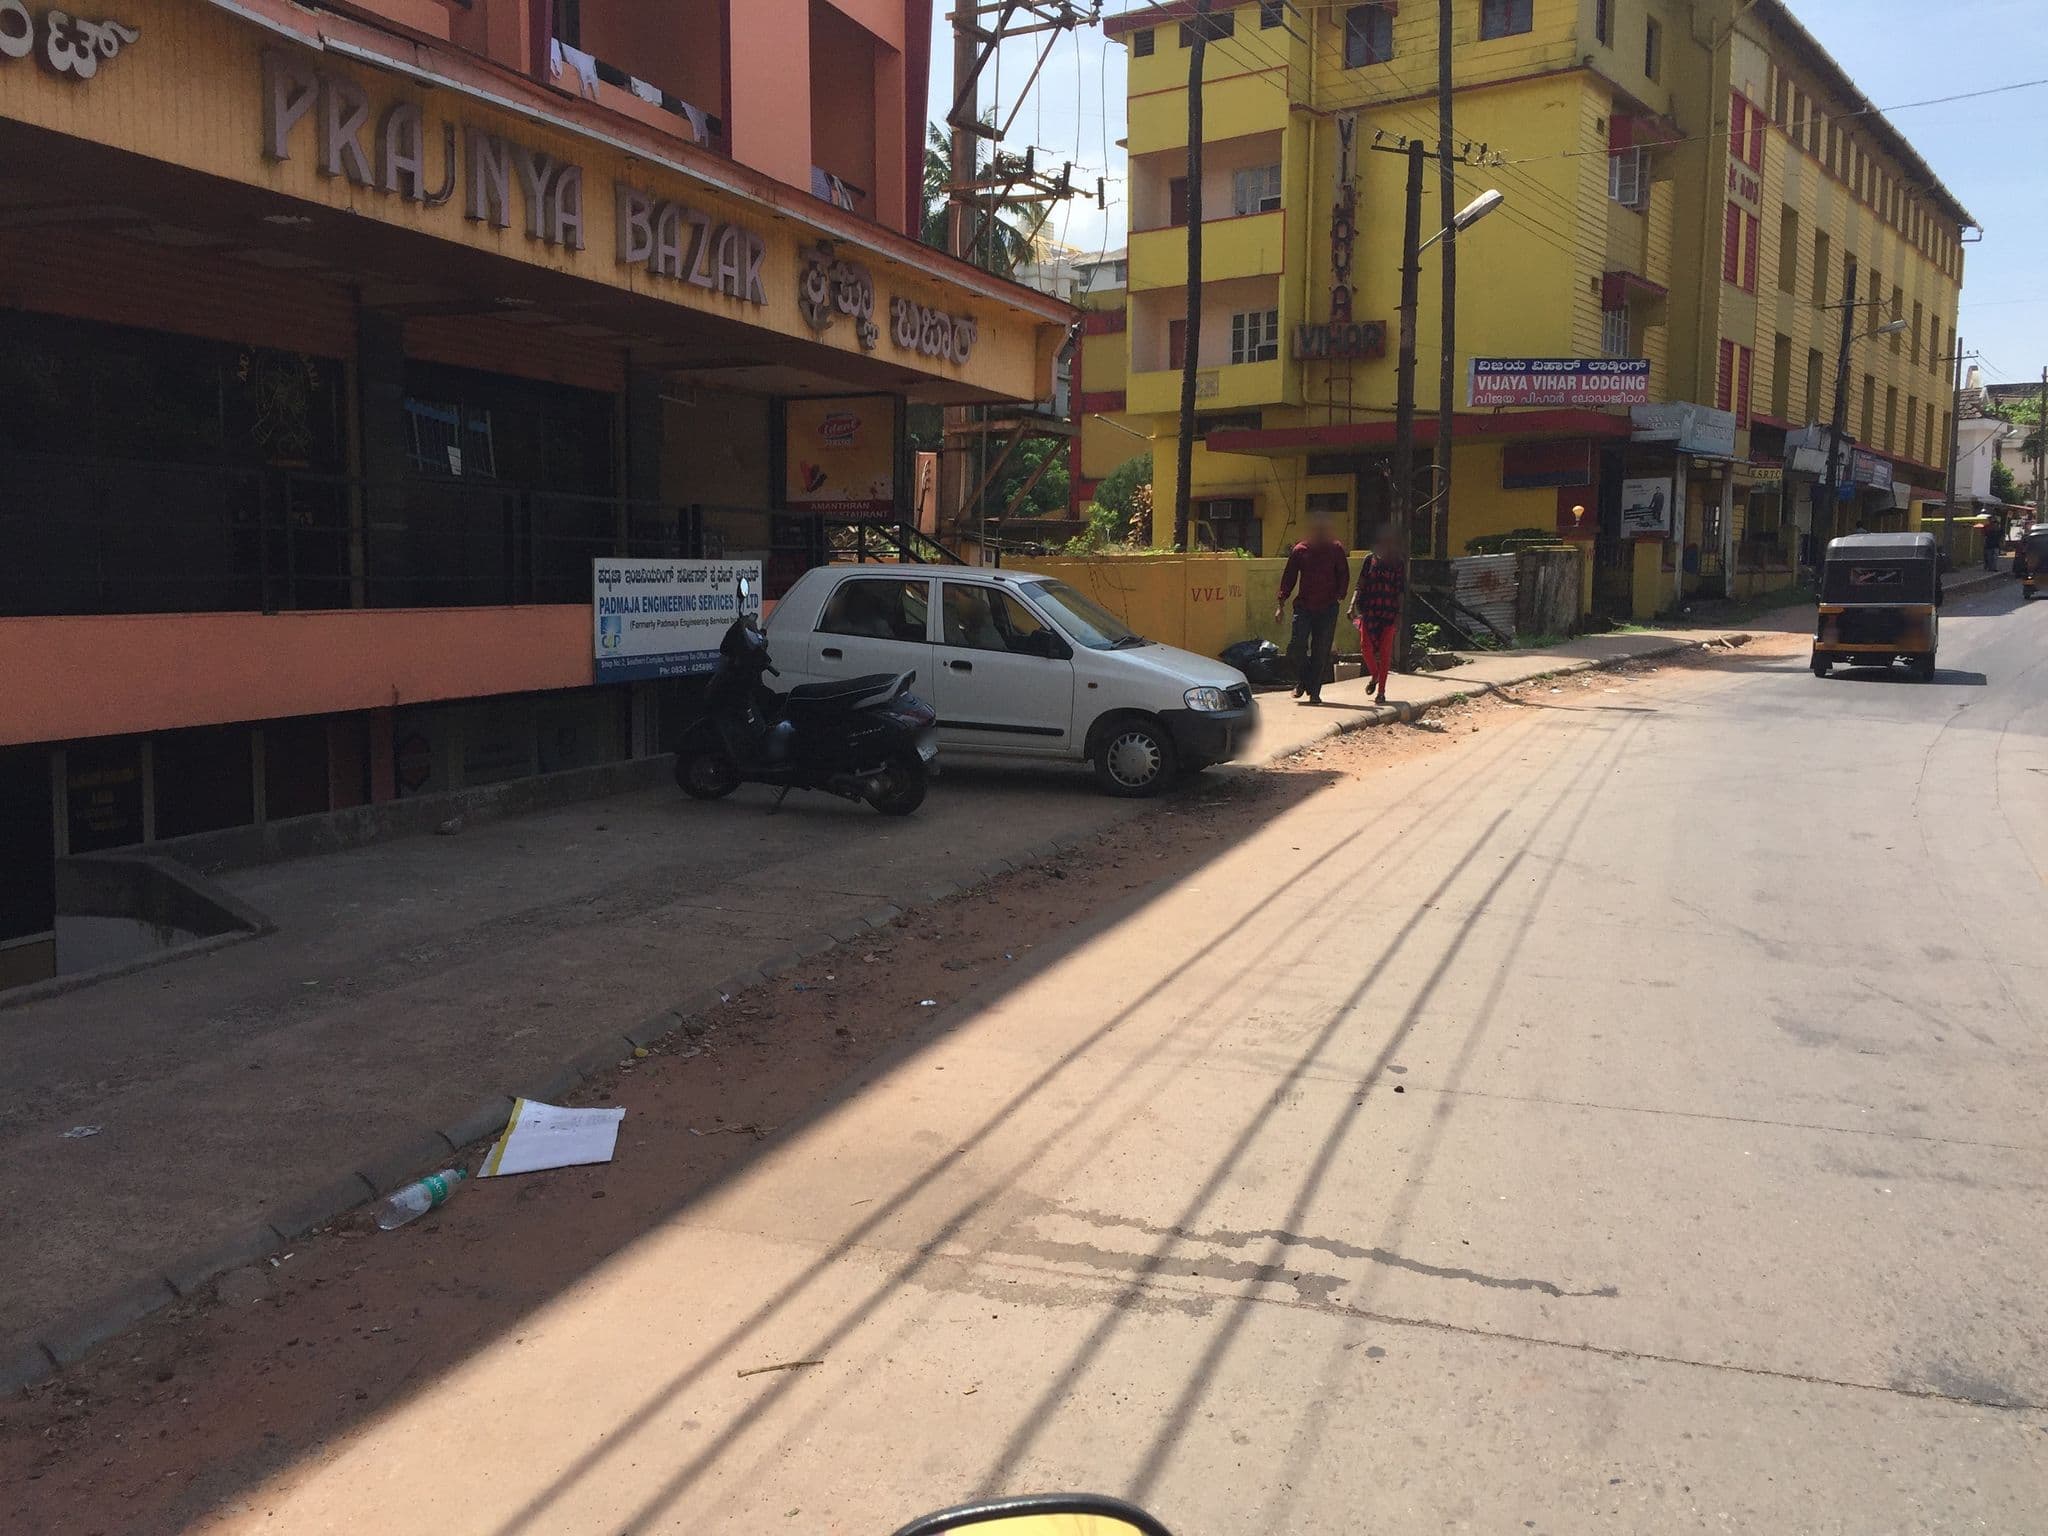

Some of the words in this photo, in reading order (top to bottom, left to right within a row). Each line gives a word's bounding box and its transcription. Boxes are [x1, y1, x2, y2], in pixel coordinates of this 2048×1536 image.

[264, 51, 586, 251] PRAJNYA
[1477, 375, 1528, 390] VIJAYA
[1532, 375, 1577, 390] VIHAR
[1582, 375, 1646, 390] LODGING
[599, 595, 641, 615] PADMAJA
[642, 594, 697, 613] ENGINEERING
[698, 593, 734, 611] SERVICES
